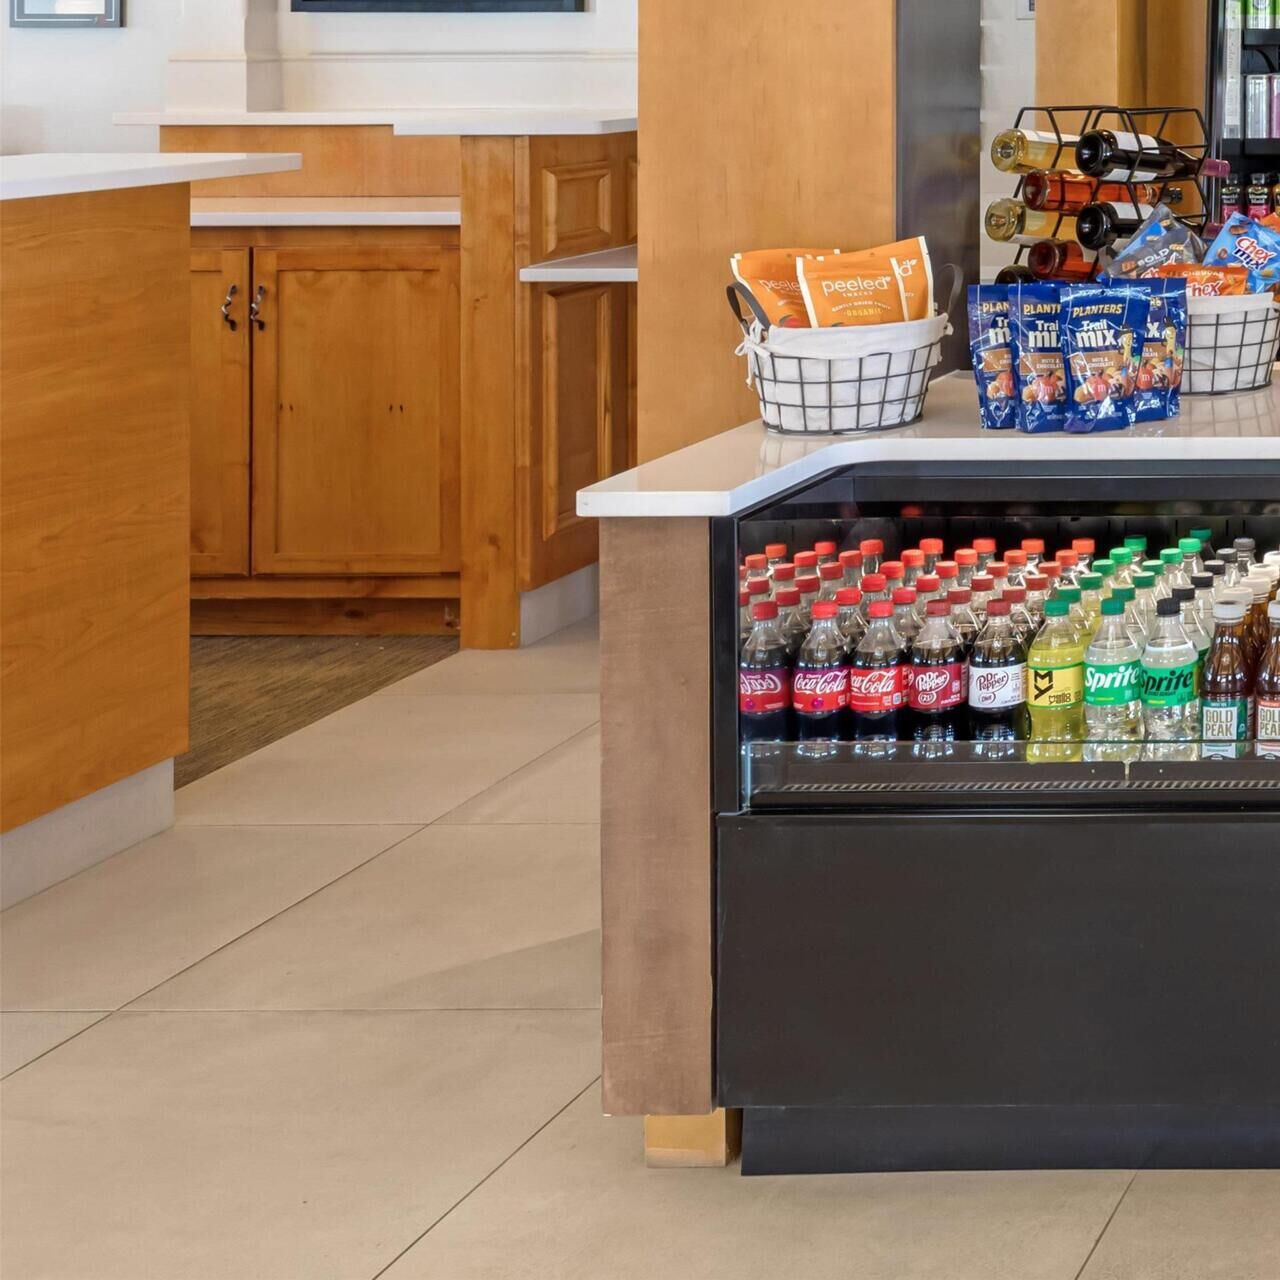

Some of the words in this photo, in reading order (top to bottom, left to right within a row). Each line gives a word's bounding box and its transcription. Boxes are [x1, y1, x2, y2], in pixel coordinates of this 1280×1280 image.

[1137, 248, 1169, 266] BOLD
[1235, 237, 1277, 262] Chex
[759, 279, 800, 292] peele
[822, 276, 889, 297] peeled
[982, 303, 1009, 313] PLAN
[1023, 304, 1060, 315] PLANT
[1073, 304, 1123, 318] PLANTERS
[1081, 319, 1107, 331] Trail
[1075, 329, 1117, 348] mix
[794, 670, 847, 694] Coca-Cola
[851, 671, 898, 693] ca-Cola
[917, 673, 948, 690] Pepper
[977, 673, 1008, 691] Pepper
[1085, 666, 1138, 692] Sprite
[1140, 670, 1193, 695] Sprite
[1205, 709, 1233, 720] GOLD
[1205, 723, 1233, 737] PEAK
